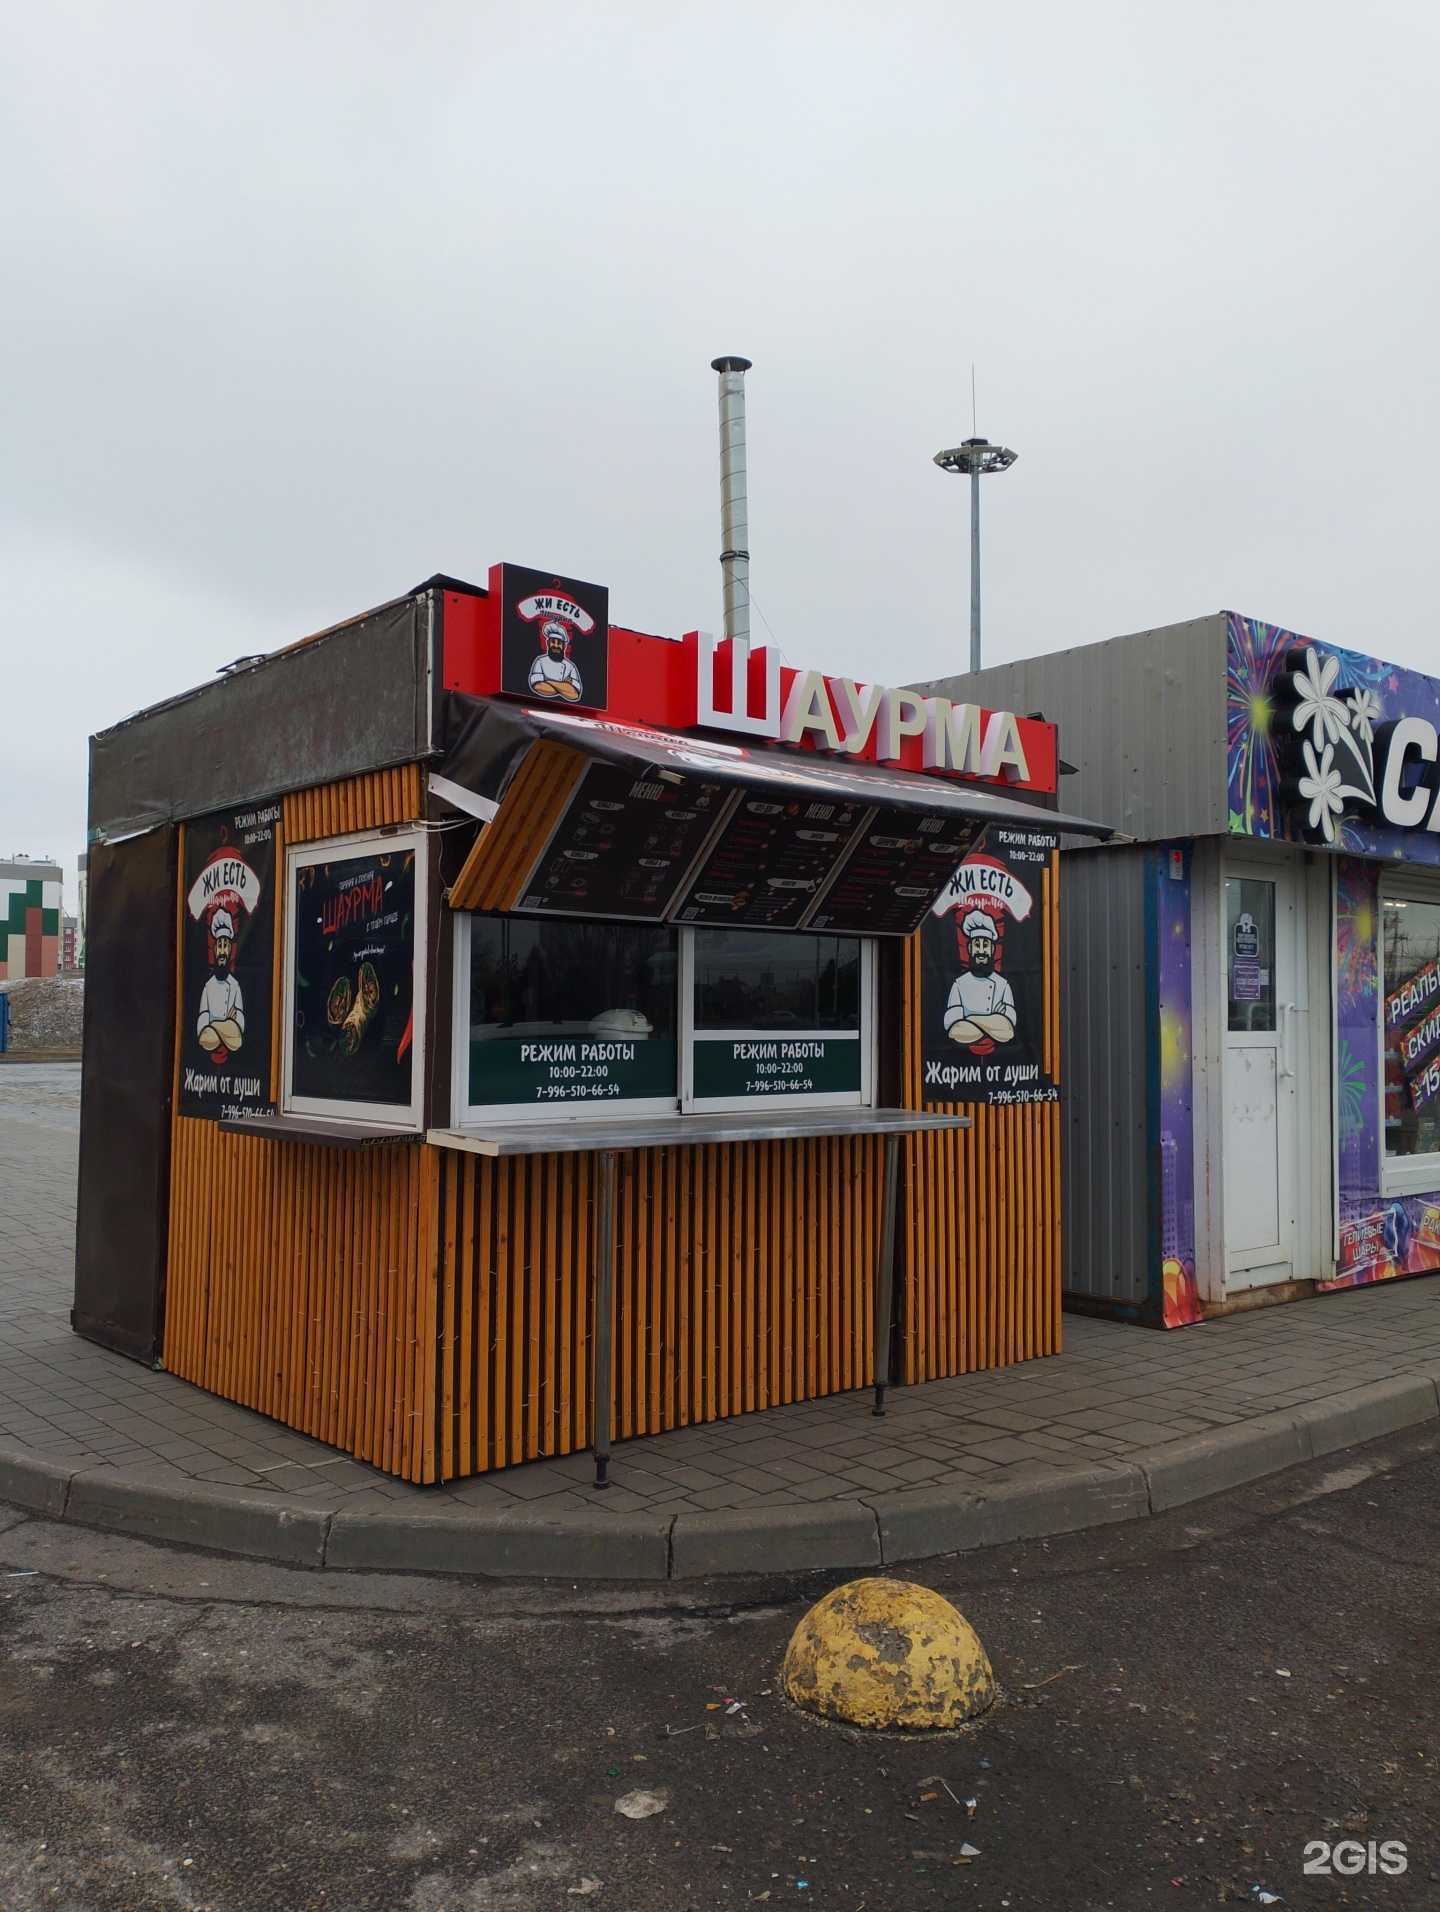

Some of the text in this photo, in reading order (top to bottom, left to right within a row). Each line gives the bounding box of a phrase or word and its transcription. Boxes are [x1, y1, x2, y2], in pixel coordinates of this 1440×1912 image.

[534, 598, 581, 619] ЖИ ЕСТЬ
[697, 630, 1031, 783] ШАУРМА
[1382, 716, 1440, 832] С
[628, 781, 665, 801] МЕНЮ
[234, 805, 281, 829] РЕЖИМ РАБОТЫ
[804, 802, 836, 820] МЕНЮ
[916, 816, 946, 834] МЕНЮ
[244, 829, 272, 844] 10:00-22:00
[998, 830, 1057, 848] РЕЖИМ РАБОТЫ
[1009, 849, 1045, 862] 10:00-22:00
[202, 861, 248, 896] ЖИ ЕСТЬ
[950, 868, 1014, 898] ЖИ ЕСТЬ
[320, 874, 385, 935] ШАУРМА
[1391, 963, 1440, 1024] РЕАЛЬ
[521, 1044, 635, 1063] РЕЖИМ РАБОТЫ
[733, 1042, 825, 1060] РЕЖИМ РАБОТЫ
[549, 1064, 608, 1079] 10:00-22:00
[755, 1062, 804, 1074] 10:00-22:00
[925, 1061, 1040, 1089] Жарим от души
[184, 1066, 261, 1104] Жарим от души
[536, 1083, 620, 1098] 7-996-510-66-54
[745, 1079, 813, 1092] 7-996-510-66-54
[988, 1088, 1058, 1104] 7-996-510-66-54
[1352, 1241, 1380, 1261] ШАРЫ
